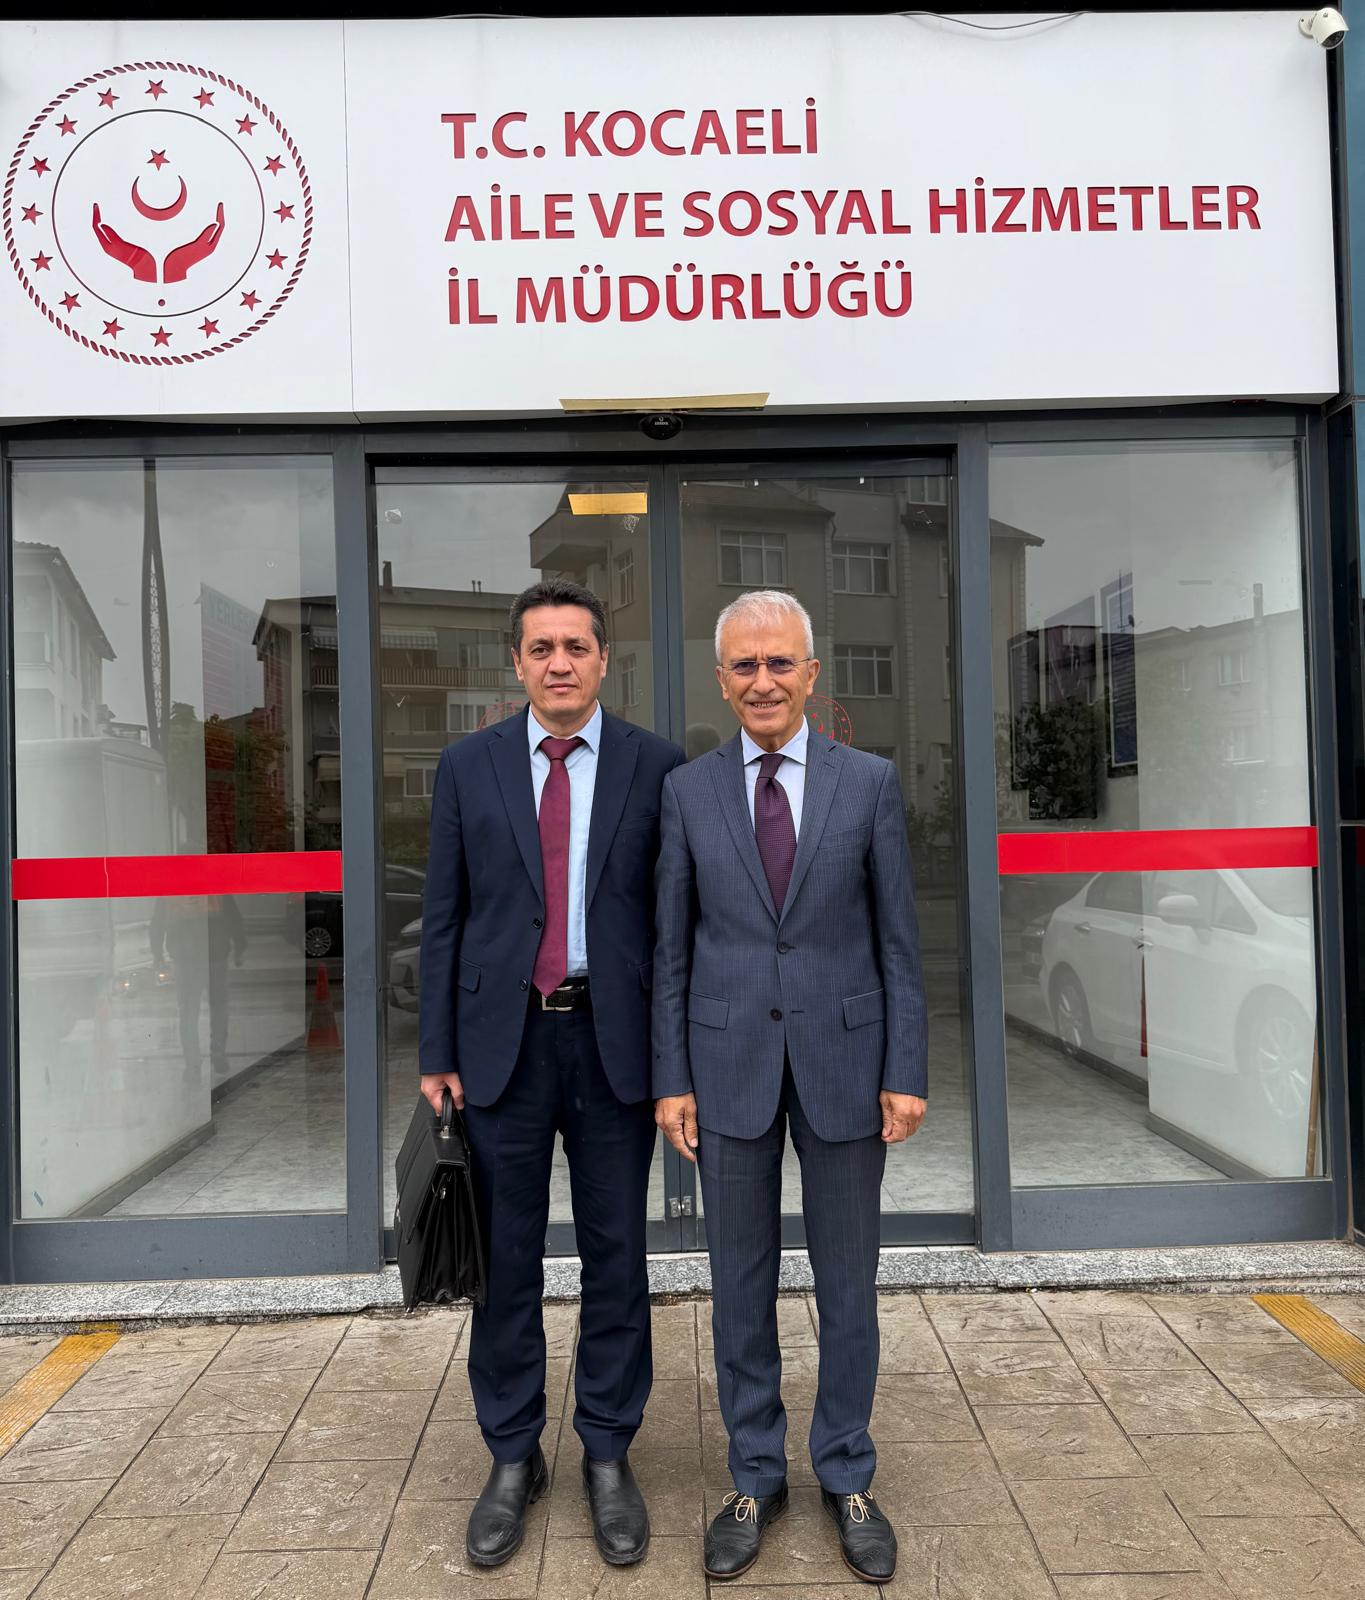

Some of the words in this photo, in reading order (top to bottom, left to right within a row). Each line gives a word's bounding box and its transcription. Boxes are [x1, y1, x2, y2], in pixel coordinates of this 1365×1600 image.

[441, 111, 546, 159] T.C.
[564, 97, 818, 157] KOCAELİ
[444, 183, 575, 242] AİLE
[588, 192, 665, 239] VE
[682, 189, 912, 238] SOSYAL
[928, 176, 1263, 234] HİZMETLER
[448, 267, 498, 325] İL
[515, 259, 912, 324] MÜDÜRLÜĞÜ
